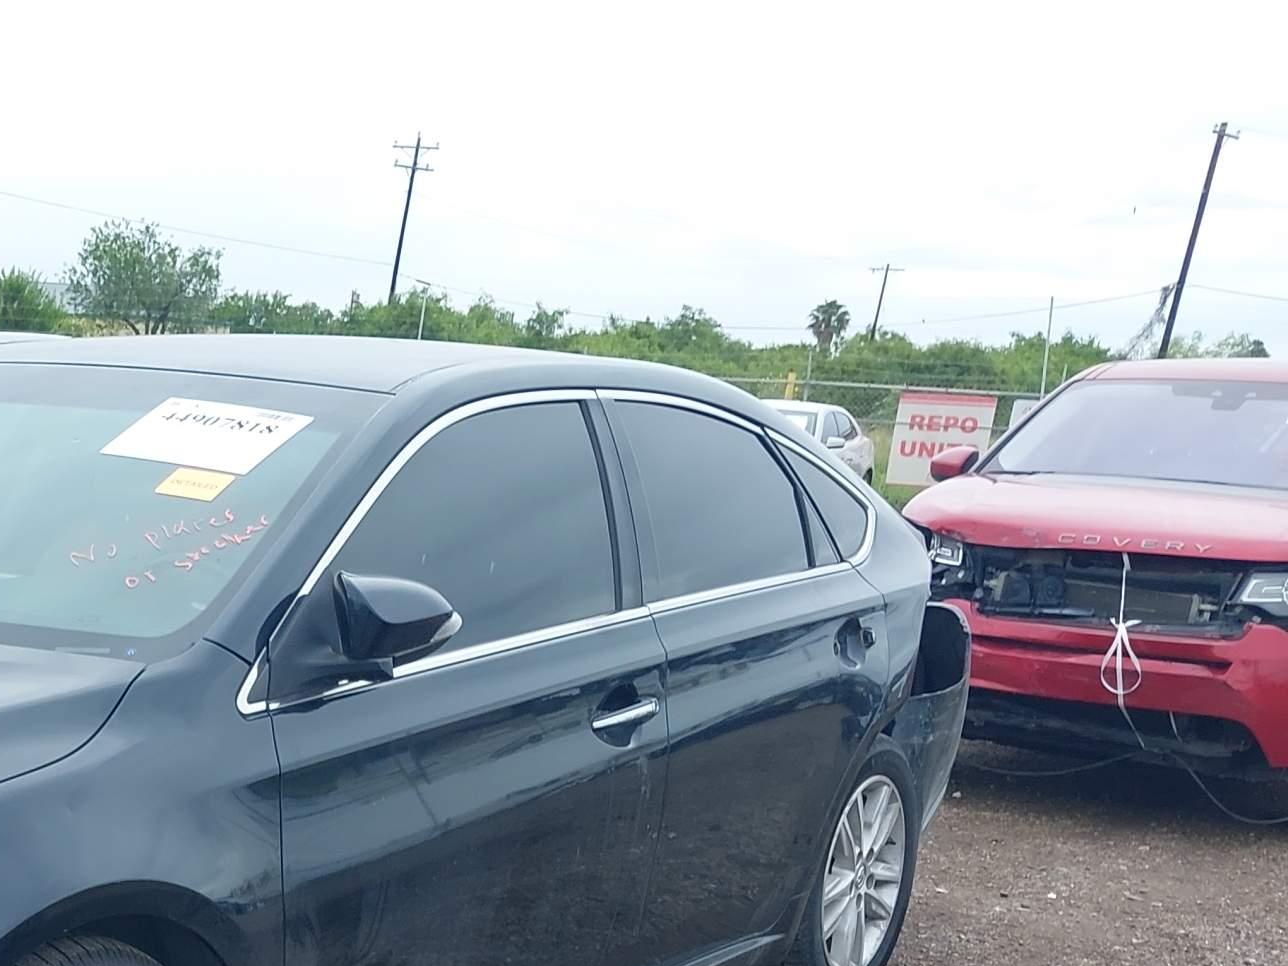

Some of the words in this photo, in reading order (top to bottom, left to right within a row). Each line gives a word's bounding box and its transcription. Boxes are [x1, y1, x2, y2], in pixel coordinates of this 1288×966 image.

[161, 411, 279, 434] 44907818
[908, 415, 979, 433] REPO
[899, 440, 979, 458] UNI
[1058, 533, 1212, 553] COVERY
